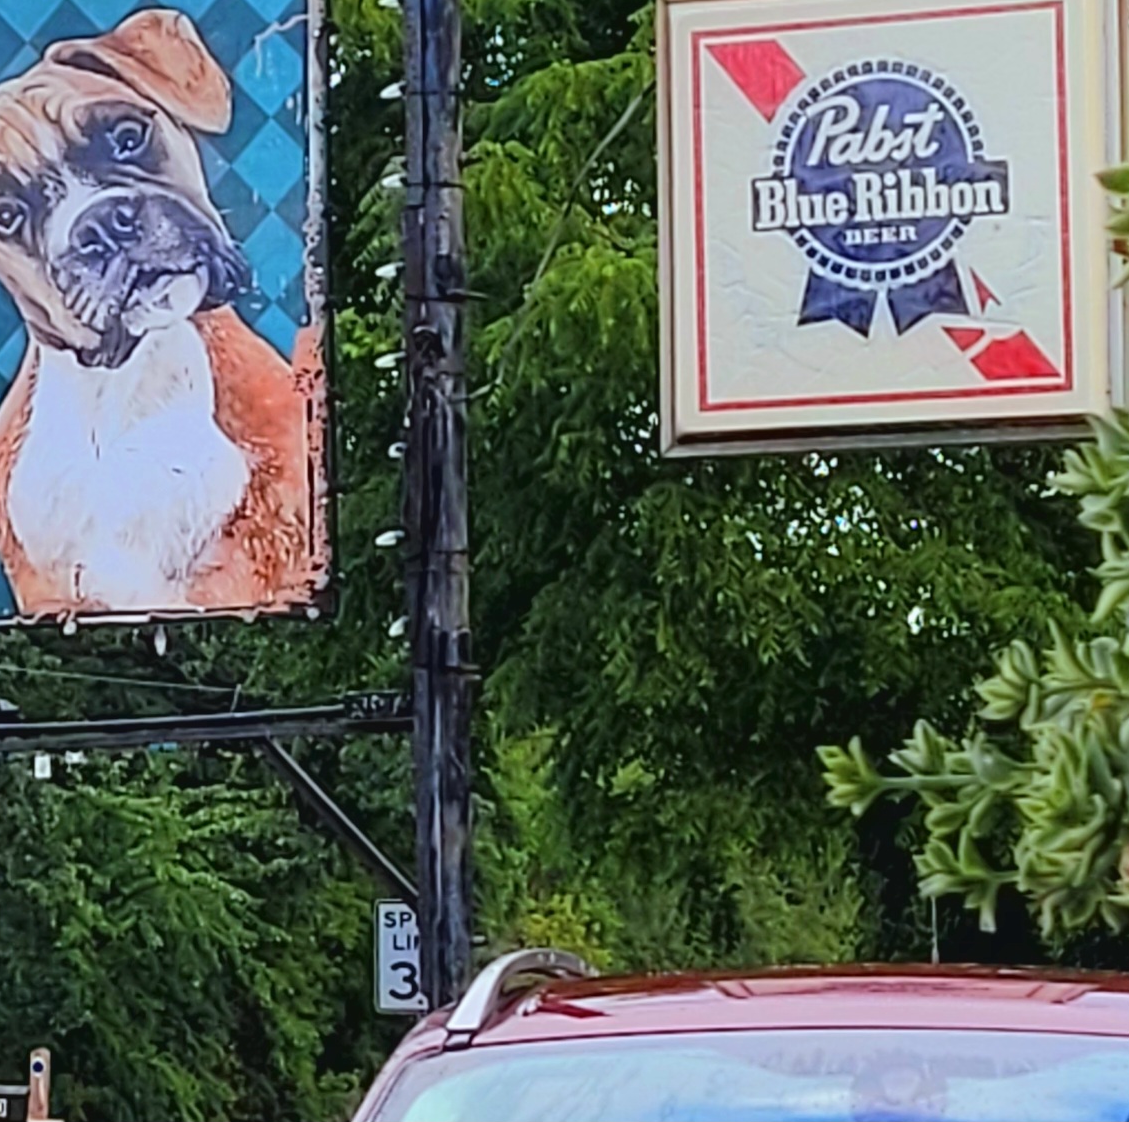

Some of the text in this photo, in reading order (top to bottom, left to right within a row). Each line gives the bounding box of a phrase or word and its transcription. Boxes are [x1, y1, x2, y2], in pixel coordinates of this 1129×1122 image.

[806, 95, 944, 166] Pabst
[756, 168, 1004, 229] Blue Ribbon
[845, 226, 918, 246] BEER
